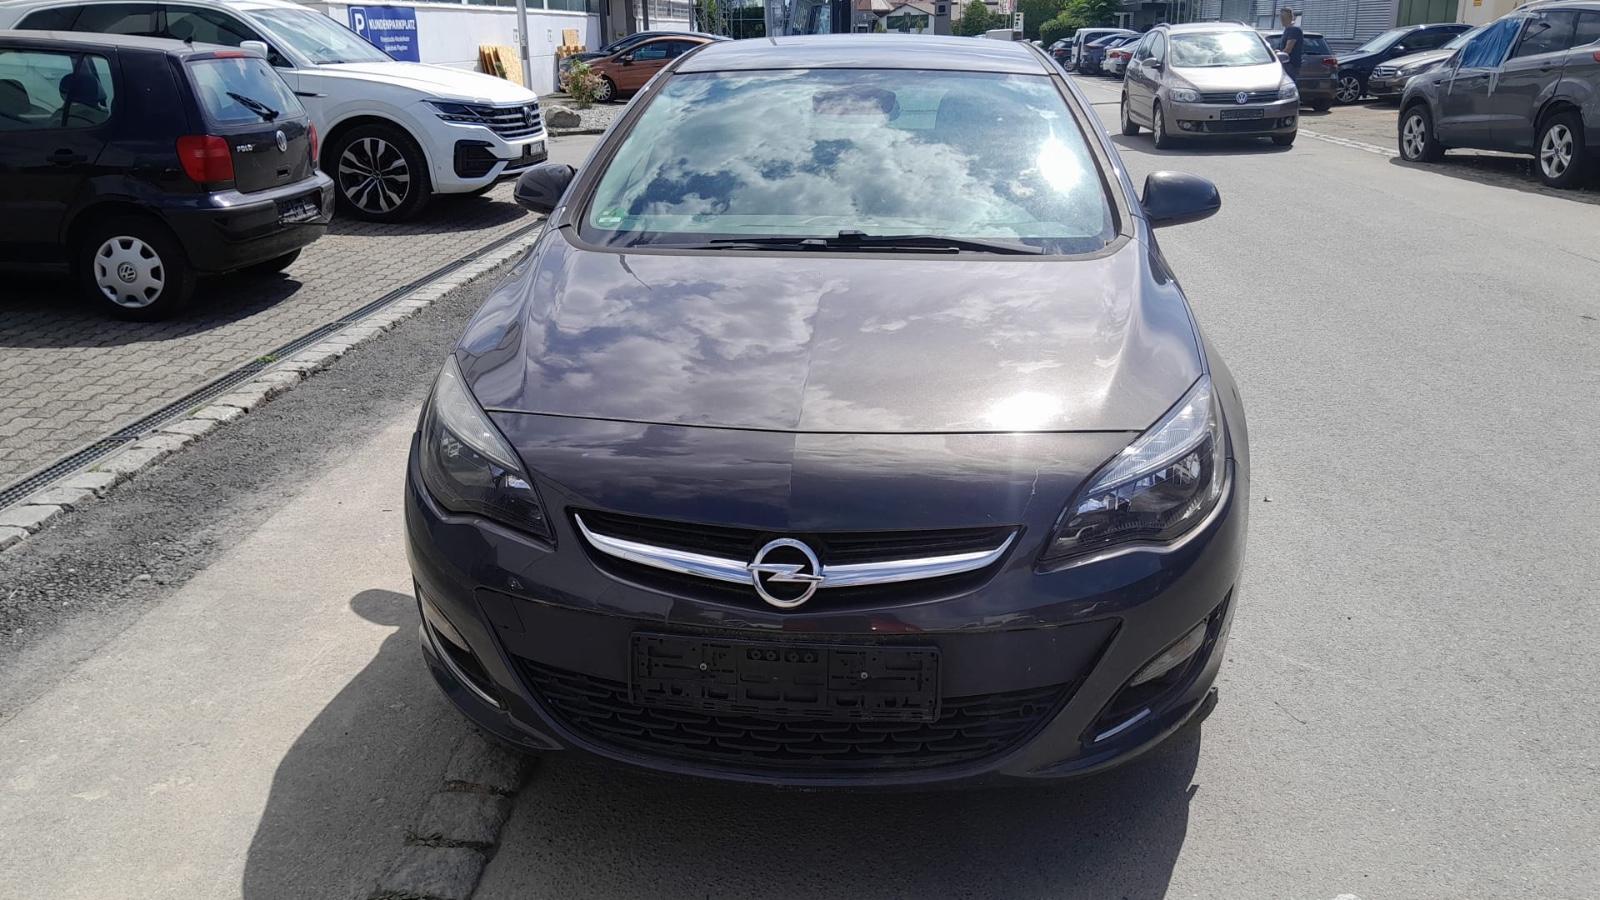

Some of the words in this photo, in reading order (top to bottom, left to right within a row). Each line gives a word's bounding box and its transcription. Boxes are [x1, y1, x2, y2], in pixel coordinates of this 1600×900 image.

[354, 13, 365, 33] P
[369, 19, 415, 30] KUNDENPARKPLATZ
[236, 144, 253, 152] POLO
